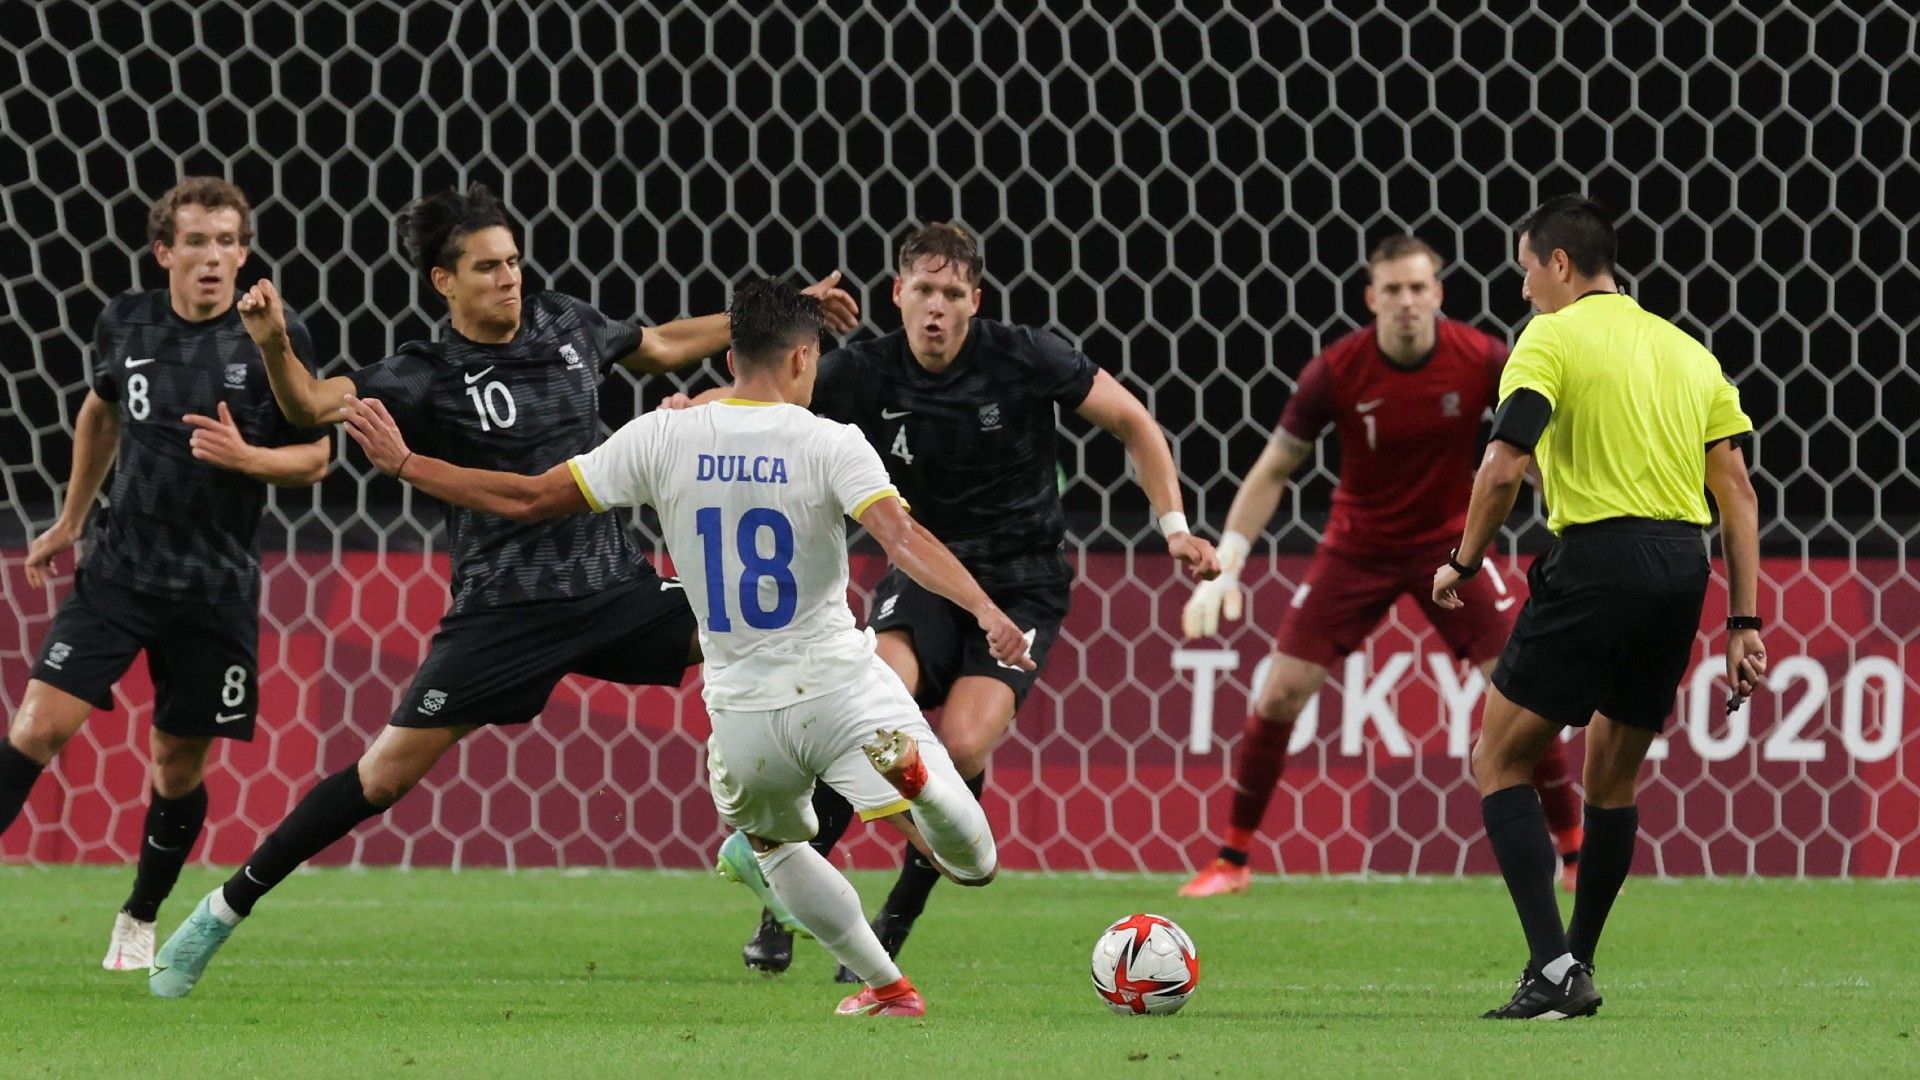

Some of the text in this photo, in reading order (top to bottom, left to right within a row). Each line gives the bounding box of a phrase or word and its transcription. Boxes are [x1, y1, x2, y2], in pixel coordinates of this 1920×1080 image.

[127, 373, 150, 420] 8
[466, 381, 517, 431] 10
[890, 424, 914, 464] 4
[1362, 415, 1376, 448] 1
[697, 454, 788, 484] DULCA
[696, 507, 797, 632] 18
[222, 665, 247, 707] 8
[1171, 650, 1905, 762] TKY 020
